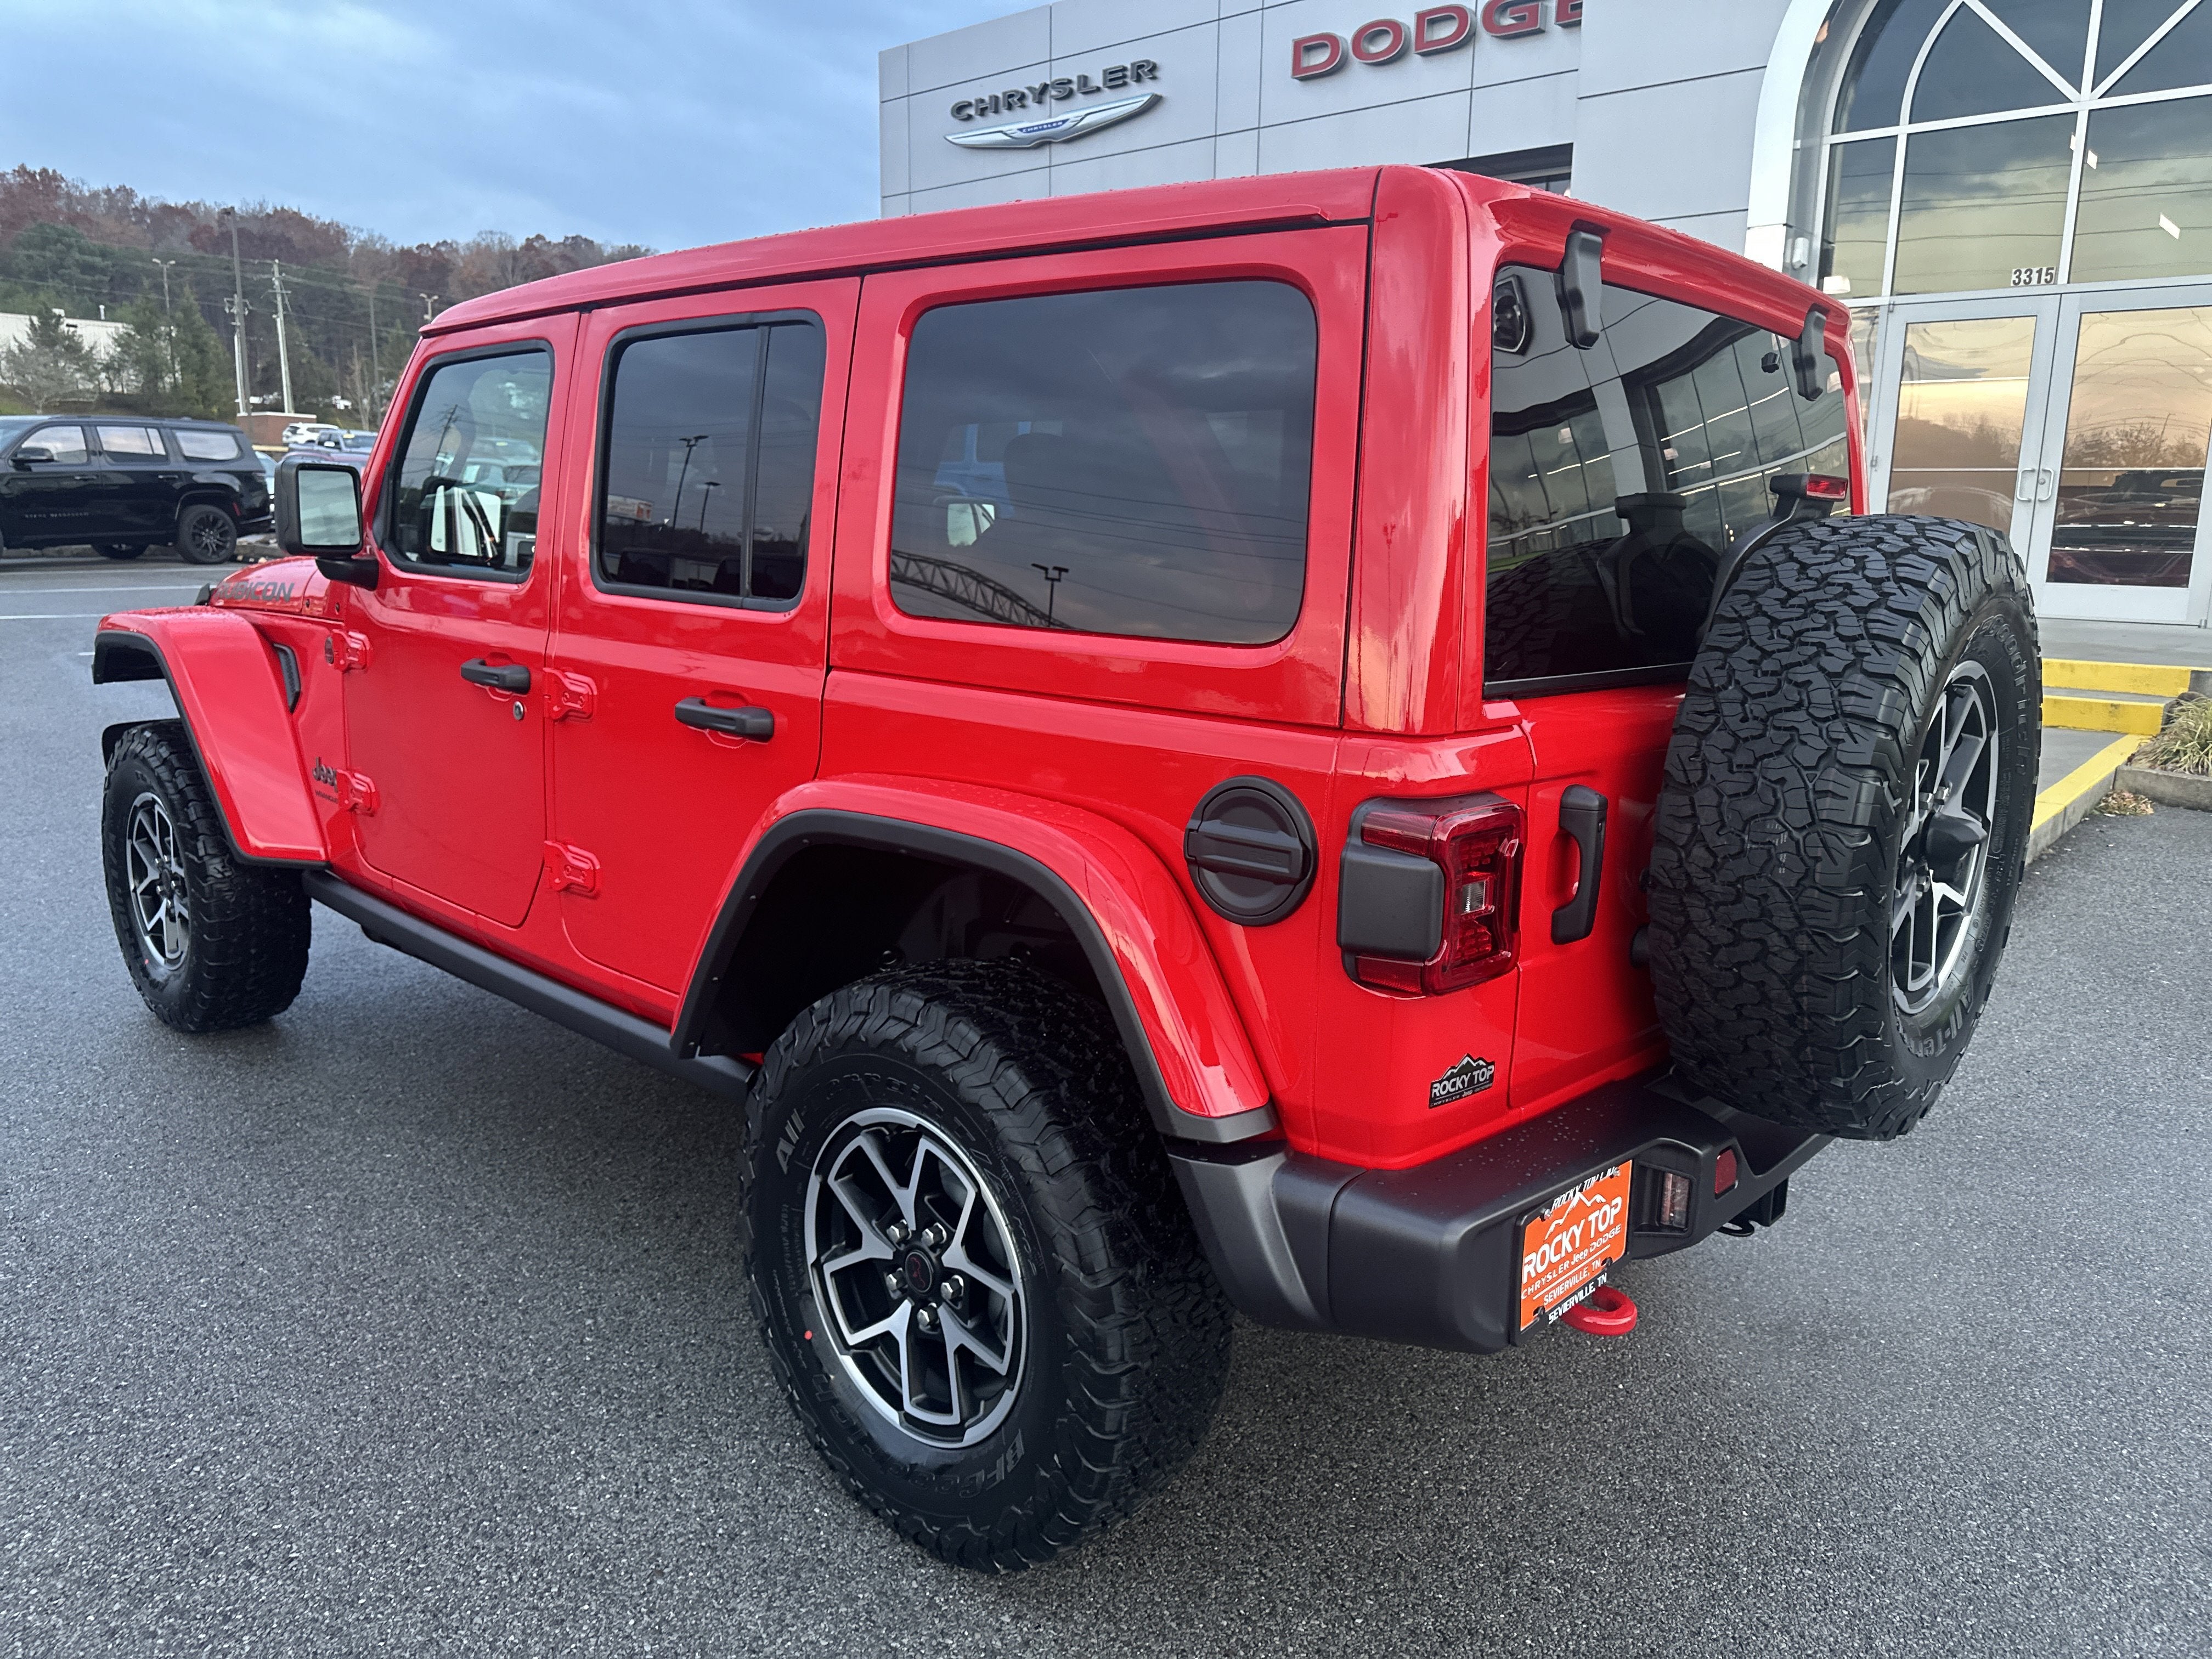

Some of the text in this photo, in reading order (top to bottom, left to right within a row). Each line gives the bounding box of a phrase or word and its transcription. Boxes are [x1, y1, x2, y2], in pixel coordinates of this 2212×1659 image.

[950, 59, 1159, 121] CHRYSLER
[2012, 267, 2055, 286] 3315
[215, 582, 295, 603] RUBICON
[1431, 1073, 1471, 1098] ROCKY
[1472, 1064, 1495, 1085] TOP
[1550, 1183, 1582, 1212] ROCKY
[1521, 1223, 1622, 1300] CHRYSLER Jeep DODGE
[1523, 1196, 1622, 1285] ROCKY TOP
[1543, 1257, 1601, 1307] SEVIERVILLE, TN
[1548, 1272, 1608, 1325] SEVIERVILLE, TN
